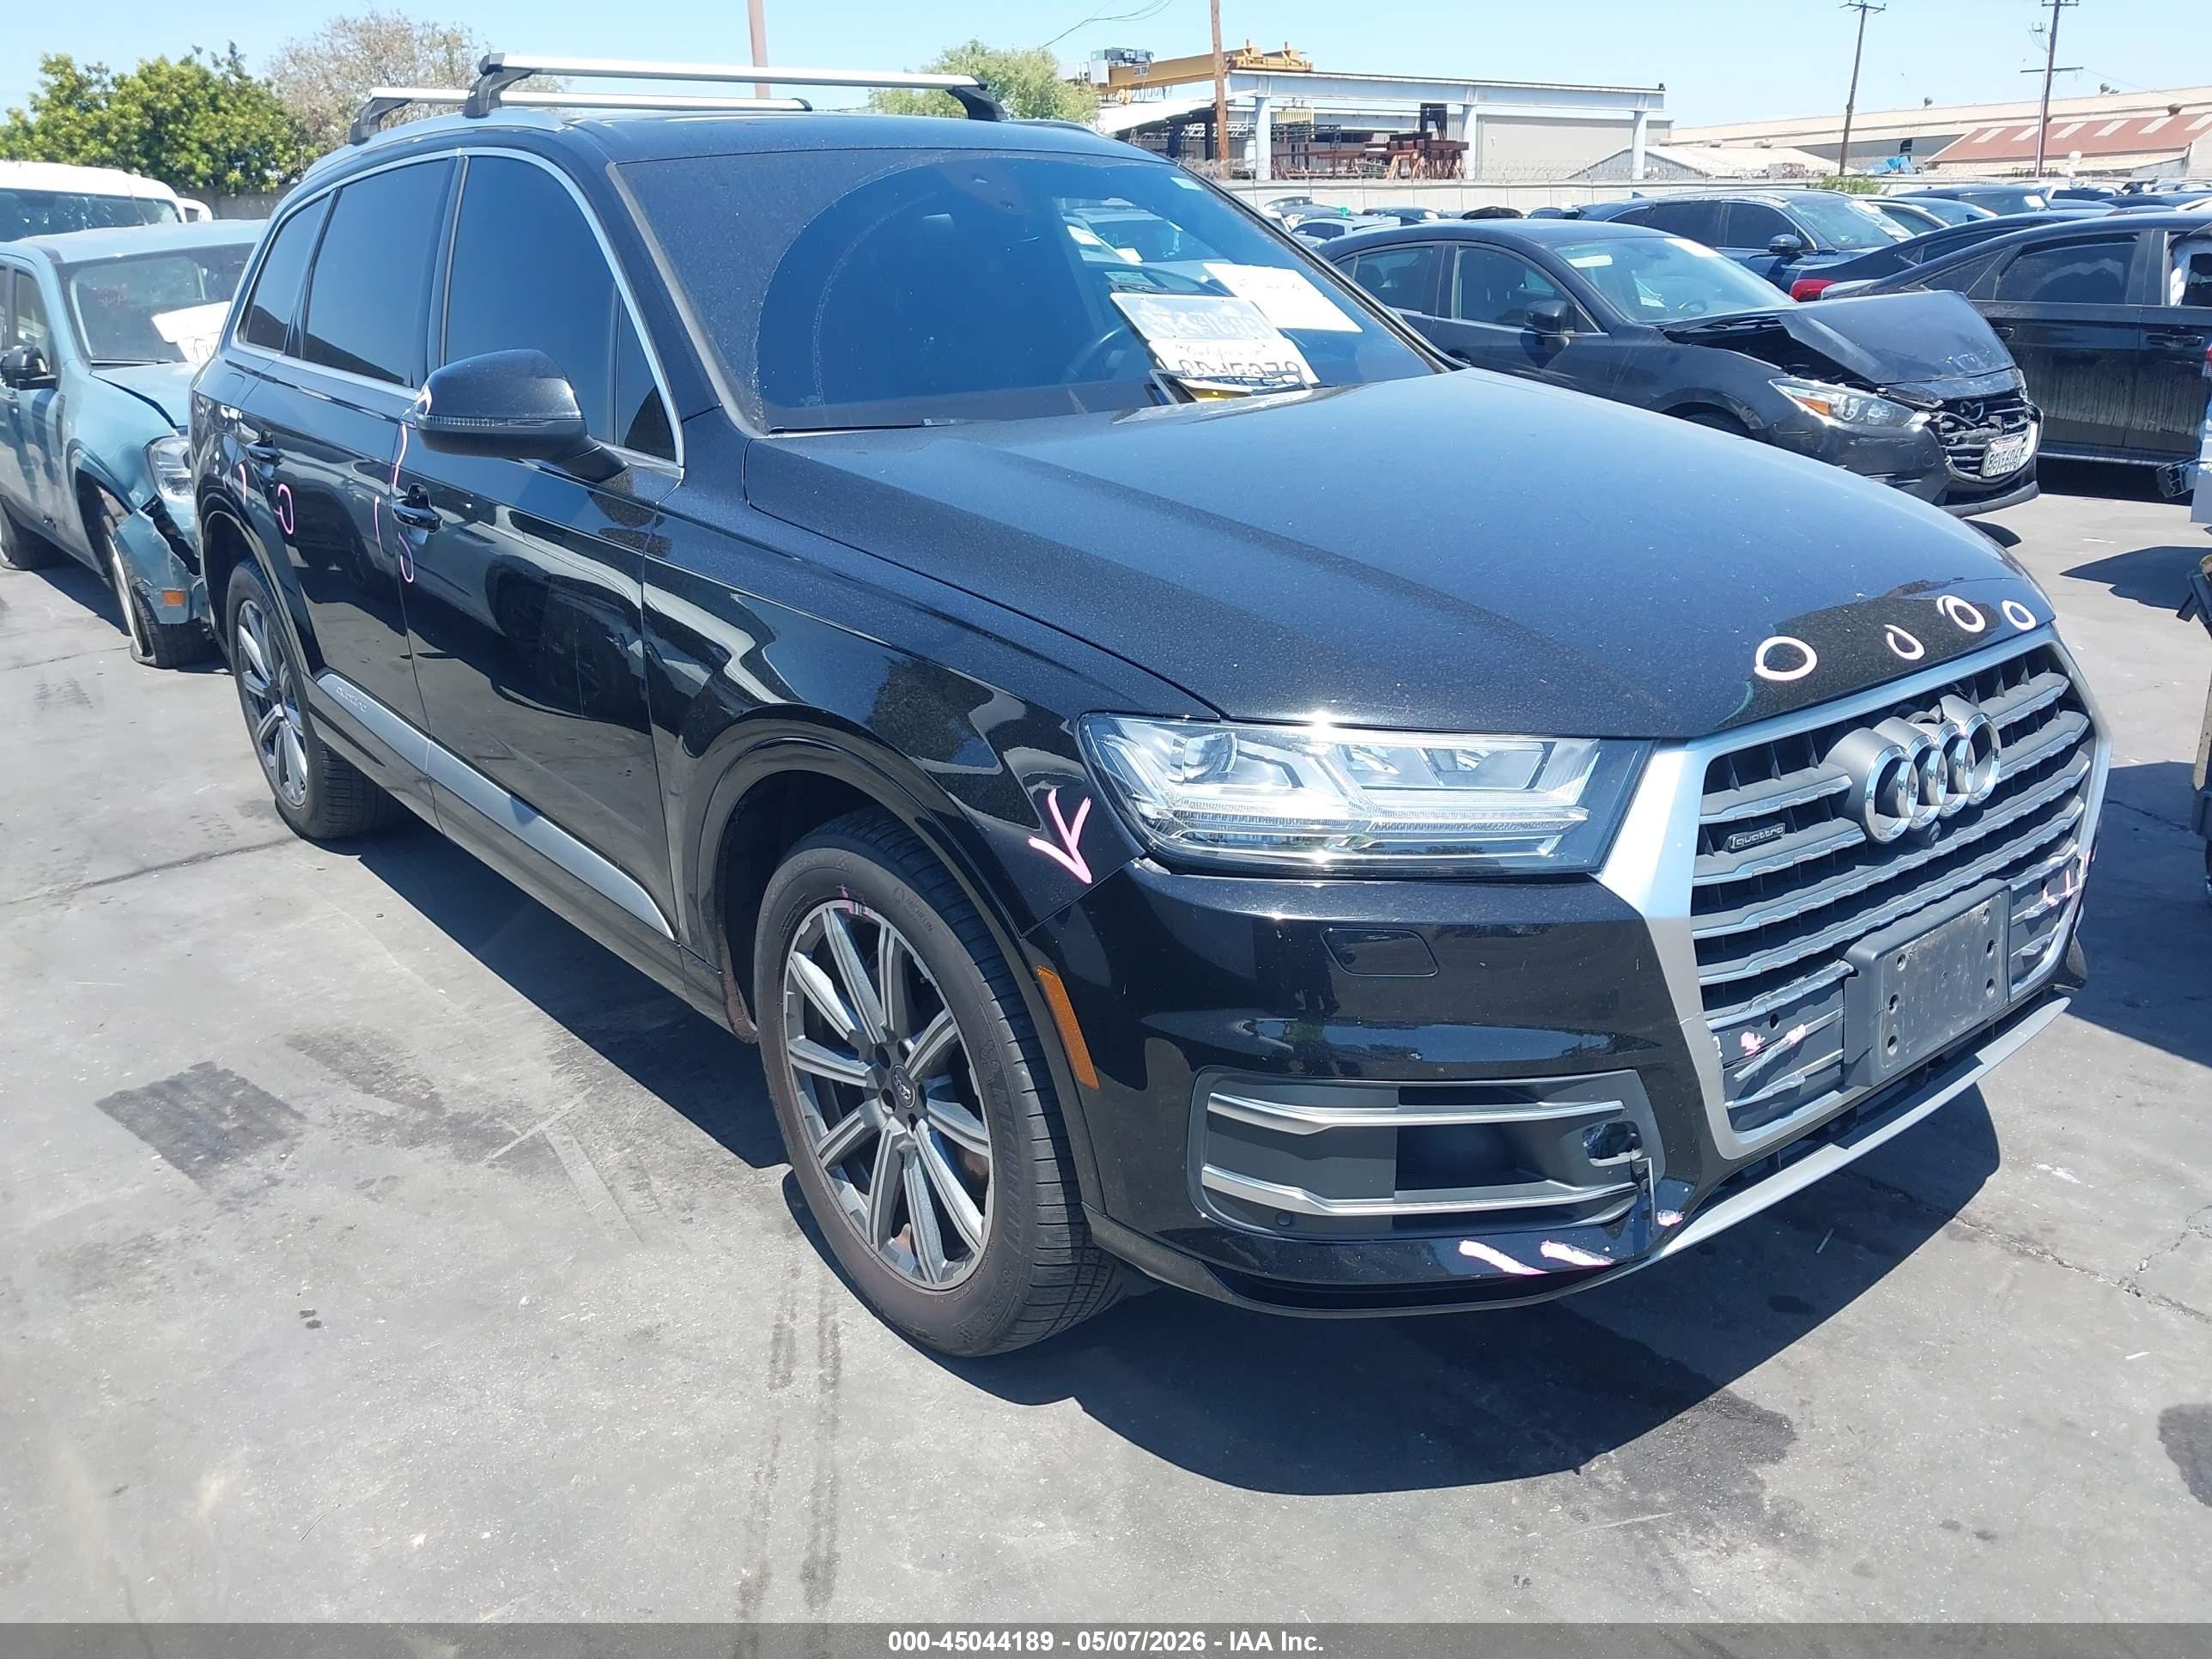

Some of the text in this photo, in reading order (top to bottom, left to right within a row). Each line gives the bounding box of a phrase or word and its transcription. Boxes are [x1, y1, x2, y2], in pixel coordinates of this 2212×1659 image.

[1736, 826, 1784, 846] quattro
[905, 898, 936, 933] MICHELIN
[991, 1085, 1023, 1256] MICHELIN
